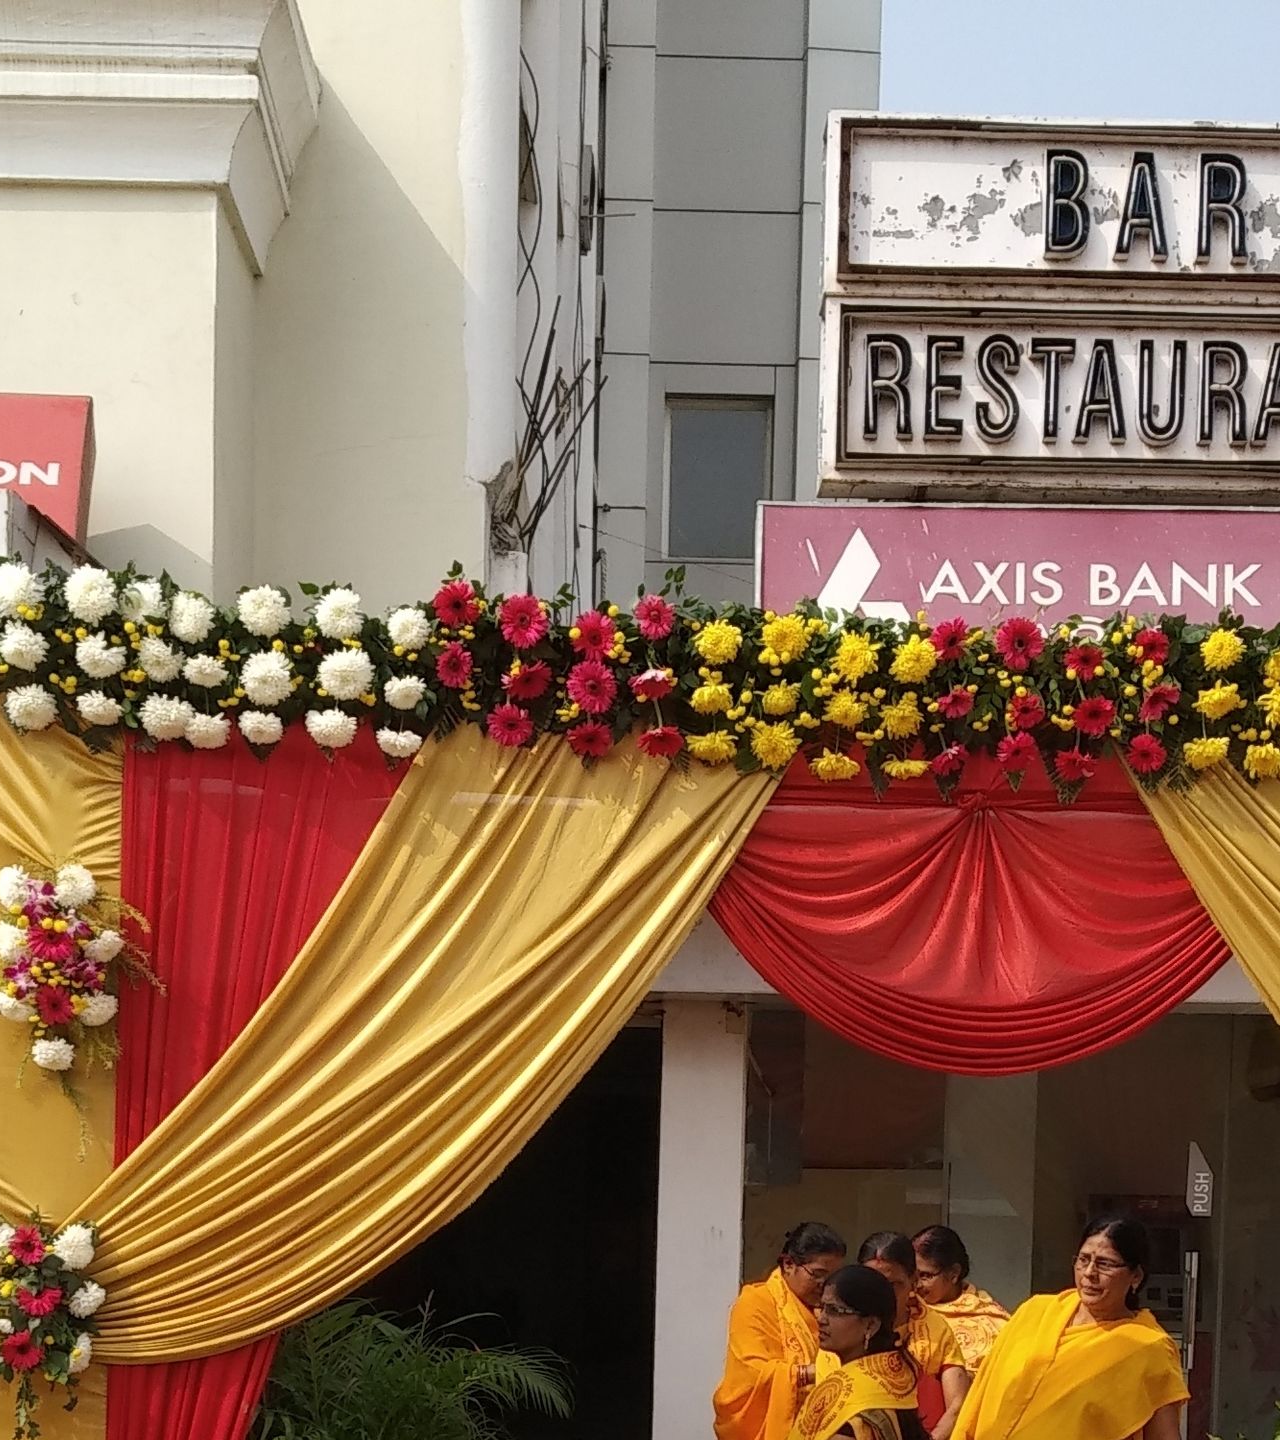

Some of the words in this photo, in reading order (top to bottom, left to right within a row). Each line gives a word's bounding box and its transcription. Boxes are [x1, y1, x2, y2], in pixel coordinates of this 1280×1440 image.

[1042, 147, 1250, 266] BAR
[922, 558, 1064, 606] AXIS
[1089, 561, 1262, 608] BANK
[1193, 1172, 1210, 1213] PUSH
